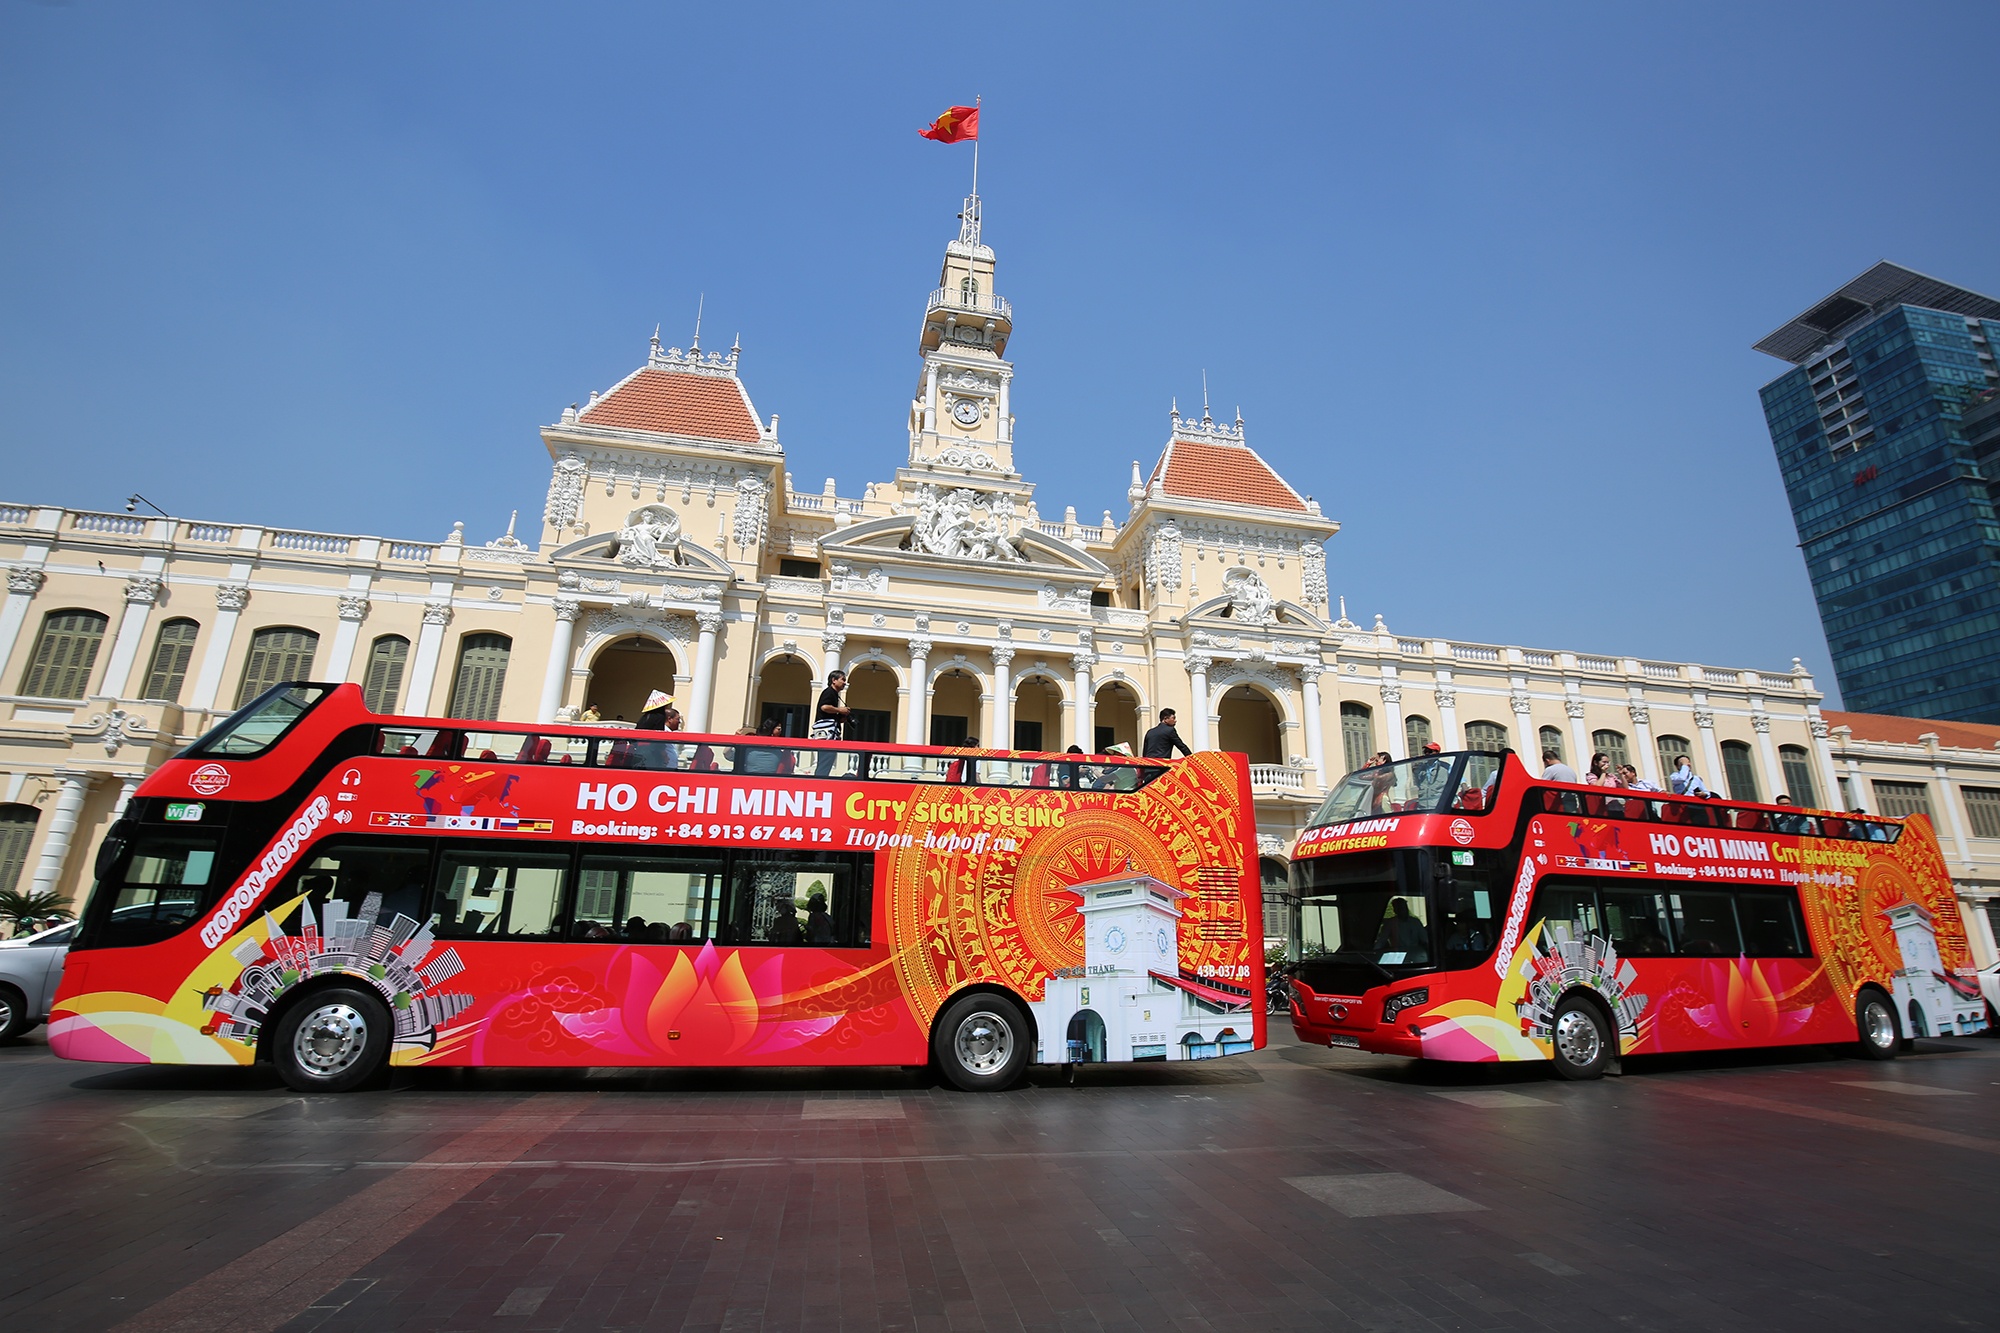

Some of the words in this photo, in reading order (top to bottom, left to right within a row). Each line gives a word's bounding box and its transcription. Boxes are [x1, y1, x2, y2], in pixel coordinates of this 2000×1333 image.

[576, 782, 638, 812] HO
[648, 785, 719, 814] CHI
[730, 788, 833, 818] MINH
[845, 791, 907, 821] CITY
[914, 802, 1066, 828] SIGHTSEEING
[571, 820, 658, 840] Booking:
[664, 824, 703, 838] +84
[708, 825, 745, 840] 913
[750, 826, 775, 841] 67
[779, 827, 804, 841] 44
[810, 828, 832, 843] 12
[845, 828, 1016, 854] Hopon-hopoff.vn
[1300, 828, 1320, 844] HO
[1321, 823, 1350, 840] CHI
[1350, 818, 1400, 836] MINH
[1319, 835, 1387, 853] SIGHTSEEING
[1649, 833, 1680, 856] HO
[1684, 837, 1718, 859] CHI
[1721, 838, 1770, 862] MINH
[1804, 850, 1870, 868] SIGHTSEEING
[202, 798, 328, 947] HOPON-HOPOFF
[1654, 862, 1697, 878] Booking:
[1698, 866, 1717, 877] +84
[1718, 867, 1736, 878] 913
[1738, 868, 1749, 878] 67
[1750, 868, 1762, 879] 44
[1764, 868, 1775, 879] 12
[1496, 857, 1535, 979] HOPON-HOPOFF
[1088, 964, 1115, 975] THÀNH
[1197, 965, 1250, 978] 43B-037.08
